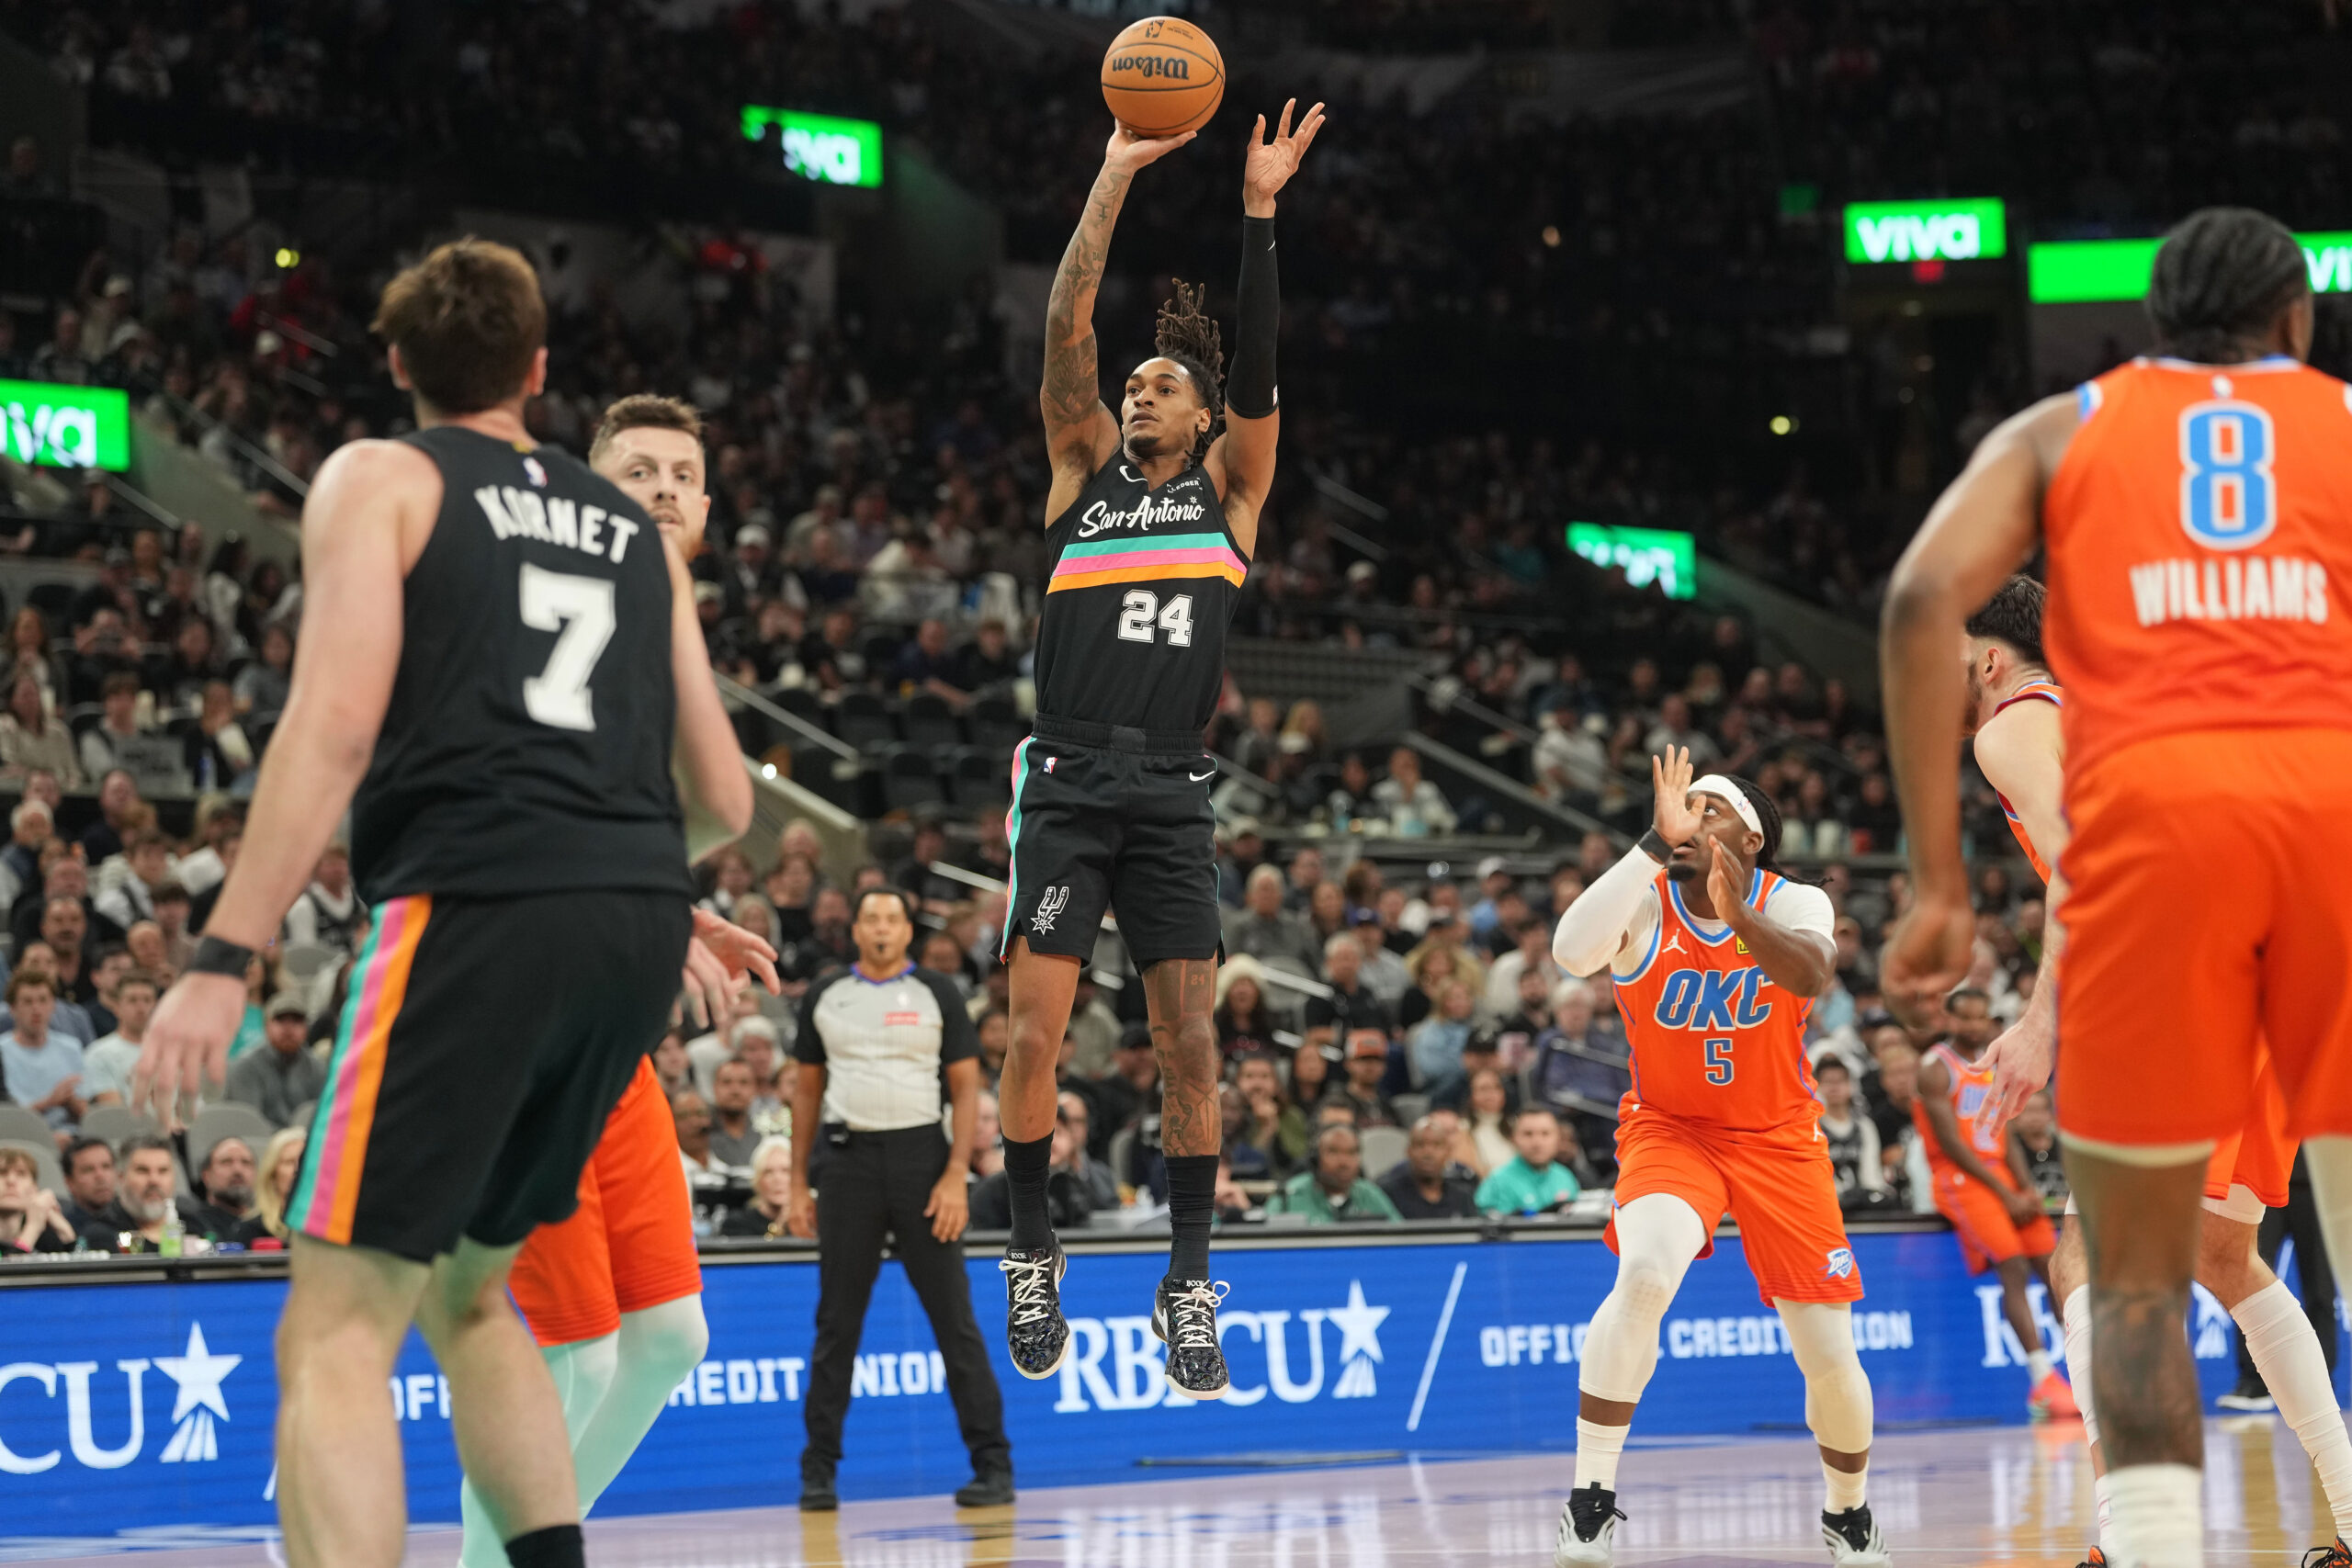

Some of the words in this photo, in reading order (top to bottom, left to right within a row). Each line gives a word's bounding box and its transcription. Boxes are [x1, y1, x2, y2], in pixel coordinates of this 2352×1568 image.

[1112, 56, 1189, 81] Wilson
[1856, 212, 1981, 263] viva
[1171, 479, 1200, 491] LEDGER
[2177, 399, 2278, 552] 8
[474, 484, 640, 564] KORNET
[1078, 500, 1126, 538] San
[1125, 495, 1205, 531] Antonio
[1118, 589, 1194, 648] 24
[2129, 556, 2329, 628] WILLIAMS
[519, 561, 617, 732] 7
[1654, 964, 1775, 1032] OKC
[1703, 1038, 1735, 1086] 5
[1053, 1308, 1326, 1413] RBCU
